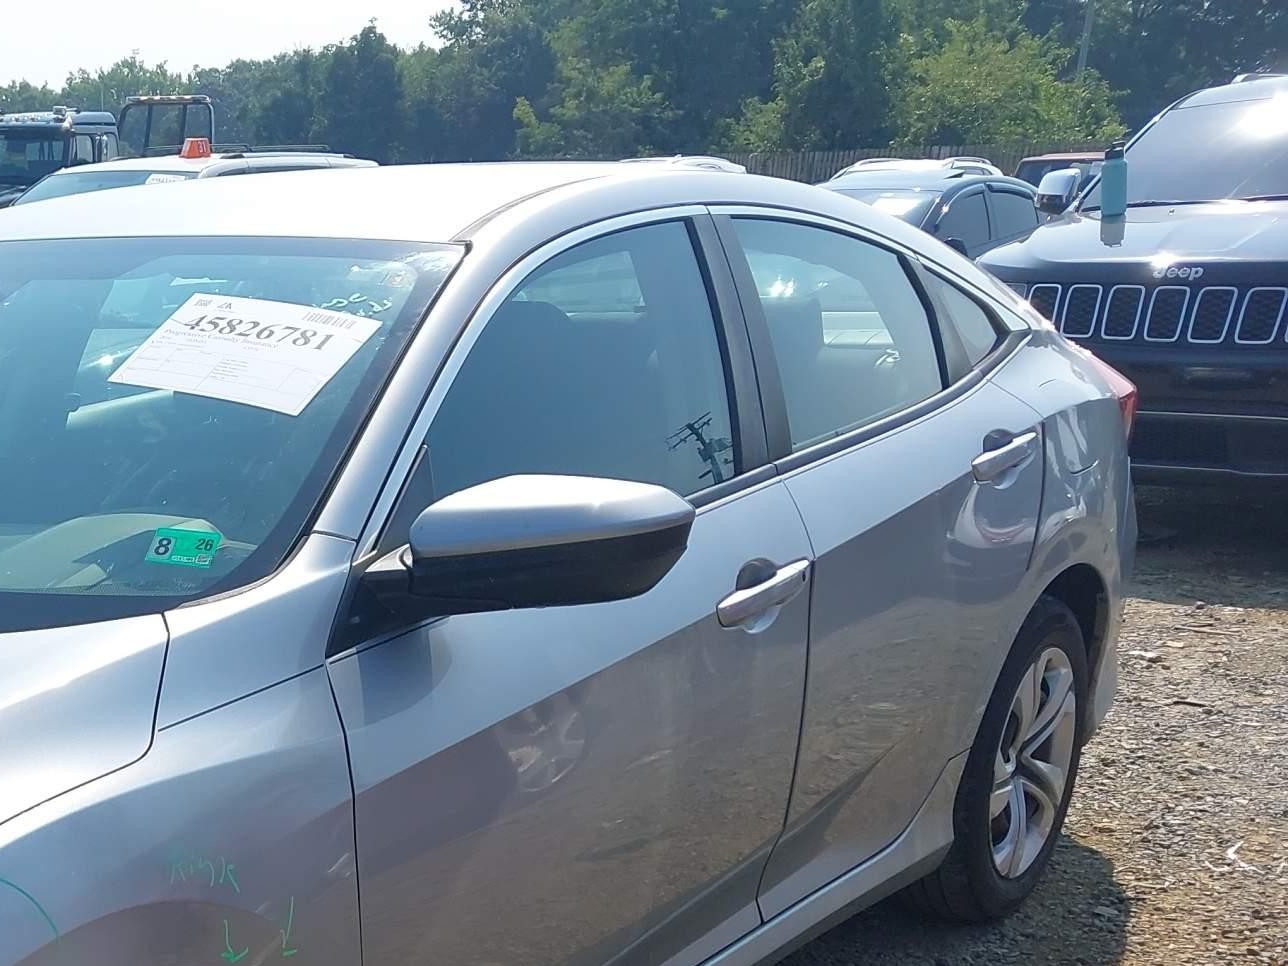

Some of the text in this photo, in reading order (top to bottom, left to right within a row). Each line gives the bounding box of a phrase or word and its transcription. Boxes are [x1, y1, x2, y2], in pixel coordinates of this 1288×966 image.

[1152, 264, 1204, 281] Jeep
[183, 314, 336, 351] 45826781
[154, 537, 214, 556] 8 26
